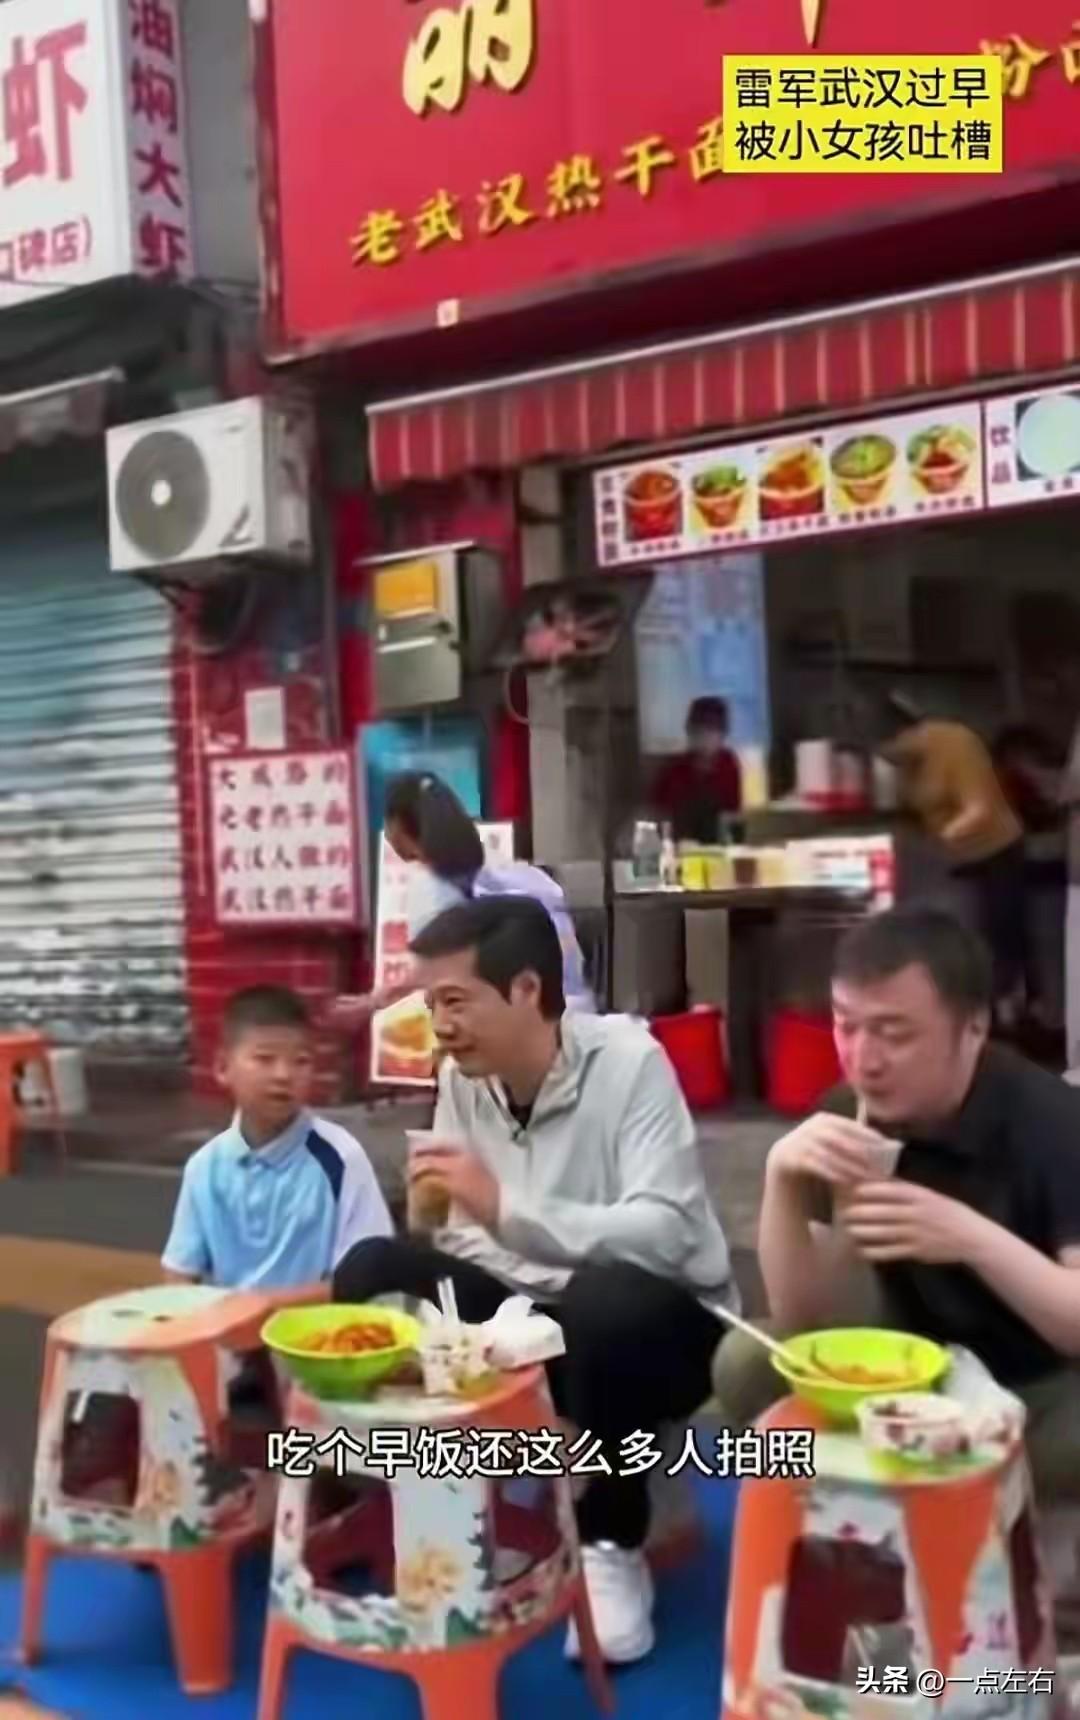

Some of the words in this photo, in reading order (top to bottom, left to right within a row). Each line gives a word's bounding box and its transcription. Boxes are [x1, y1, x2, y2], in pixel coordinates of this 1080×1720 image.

[2, 20, 88, 186] 虾
[129, 0, 187, 279] 油焖大虾
